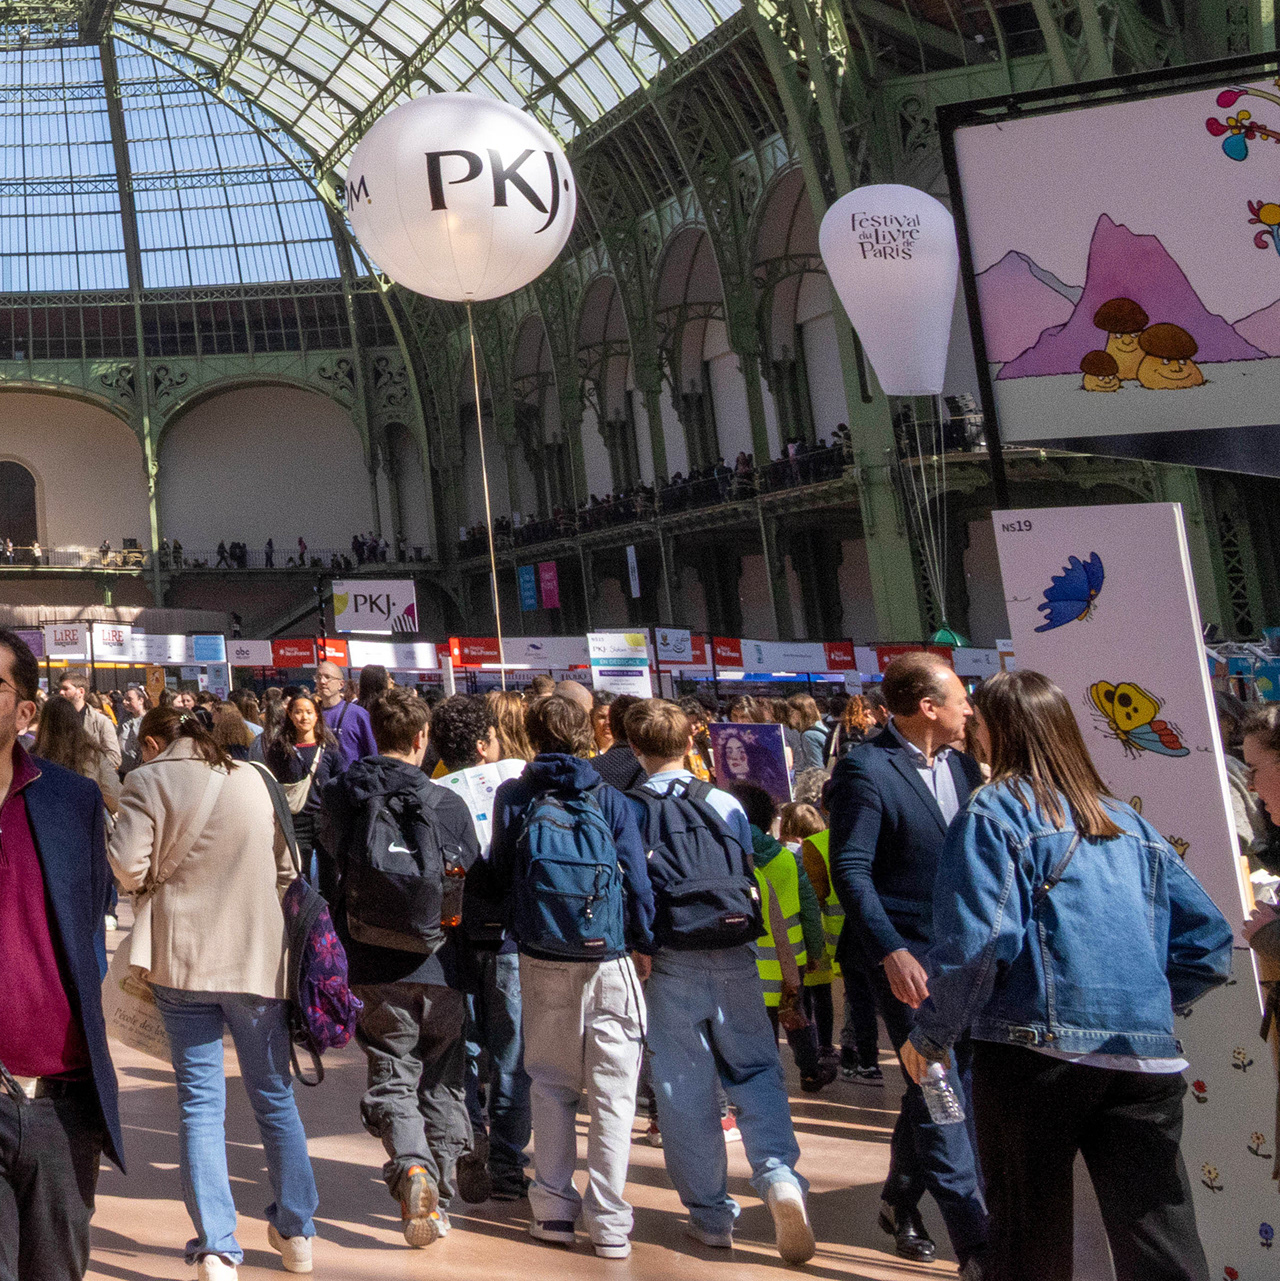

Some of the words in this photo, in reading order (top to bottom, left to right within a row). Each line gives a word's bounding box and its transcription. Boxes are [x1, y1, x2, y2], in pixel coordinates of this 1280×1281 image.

[851, 212, 920, 232] Festival
[859, 231, 873, 240] du
[874, 228, 920, 245] Livre
[1002, 520, 1032, 532] NS19
